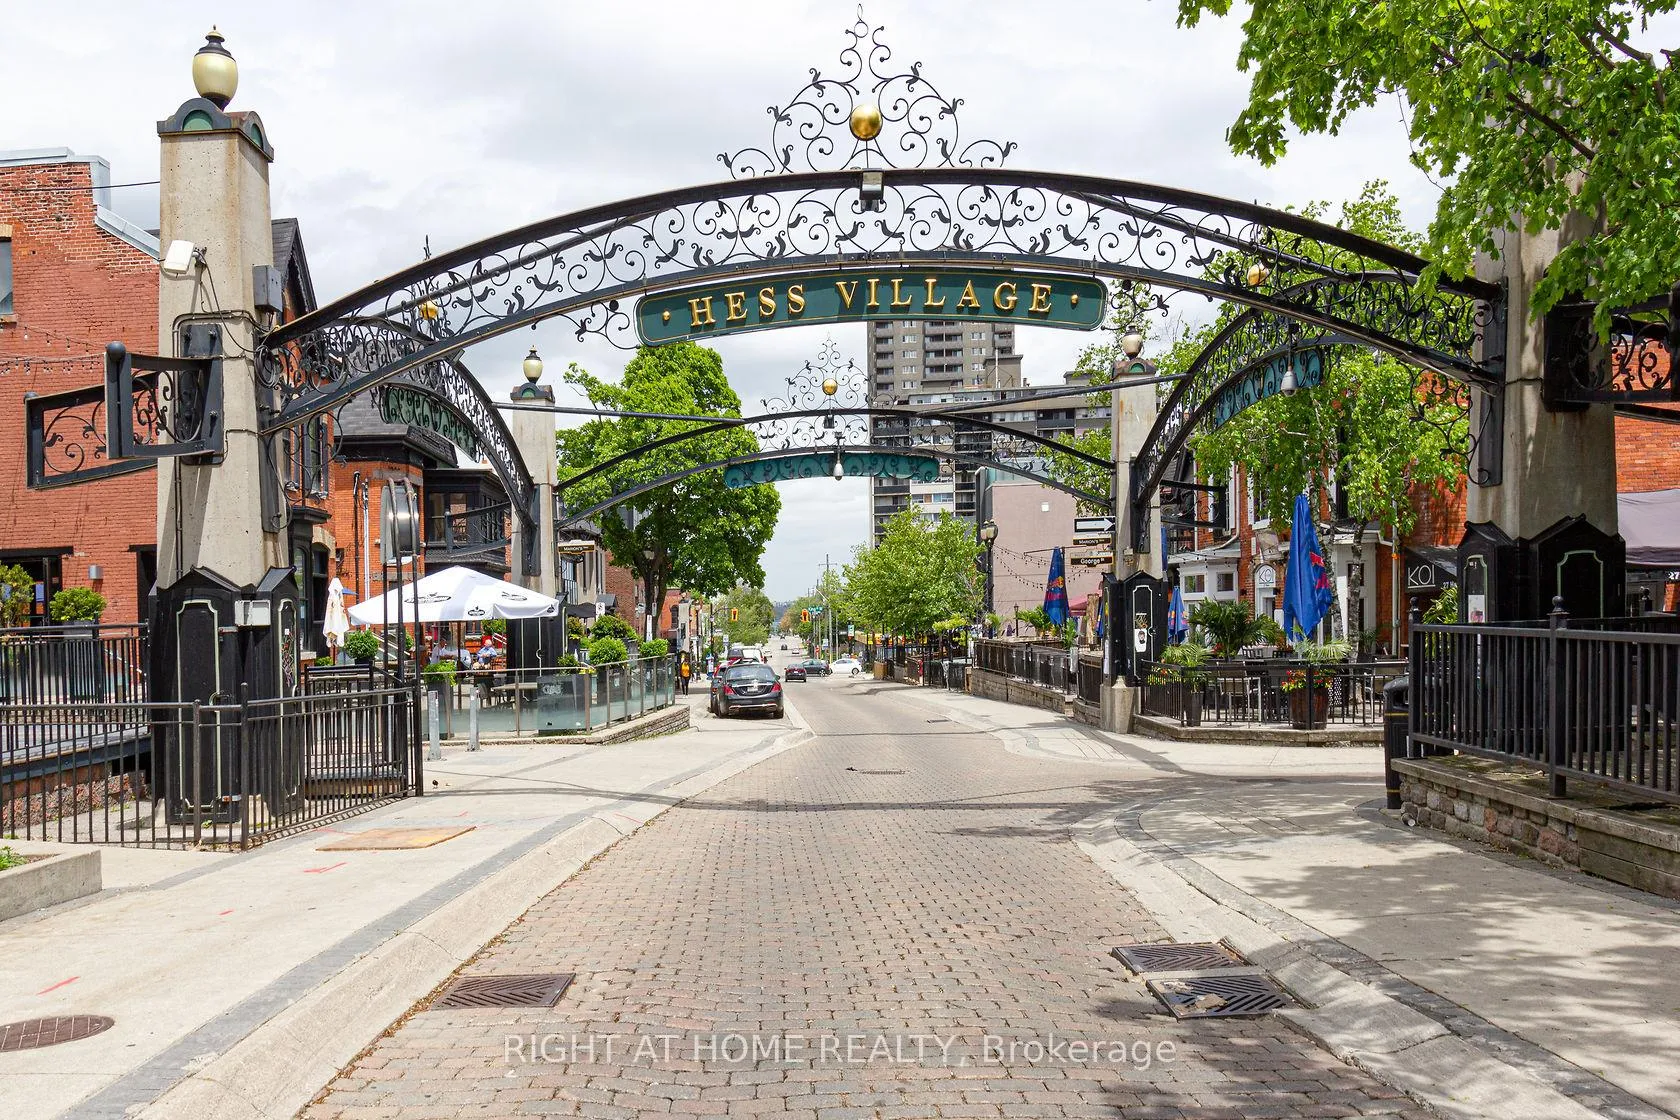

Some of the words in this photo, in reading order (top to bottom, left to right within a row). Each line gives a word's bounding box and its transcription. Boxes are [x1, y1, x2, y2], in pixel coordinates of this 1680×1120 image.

[688, 284, 805, 327] HESS
[834, 278, 1052, 313] VILLAGE
[1408, 564, 1435, 585] KOI
